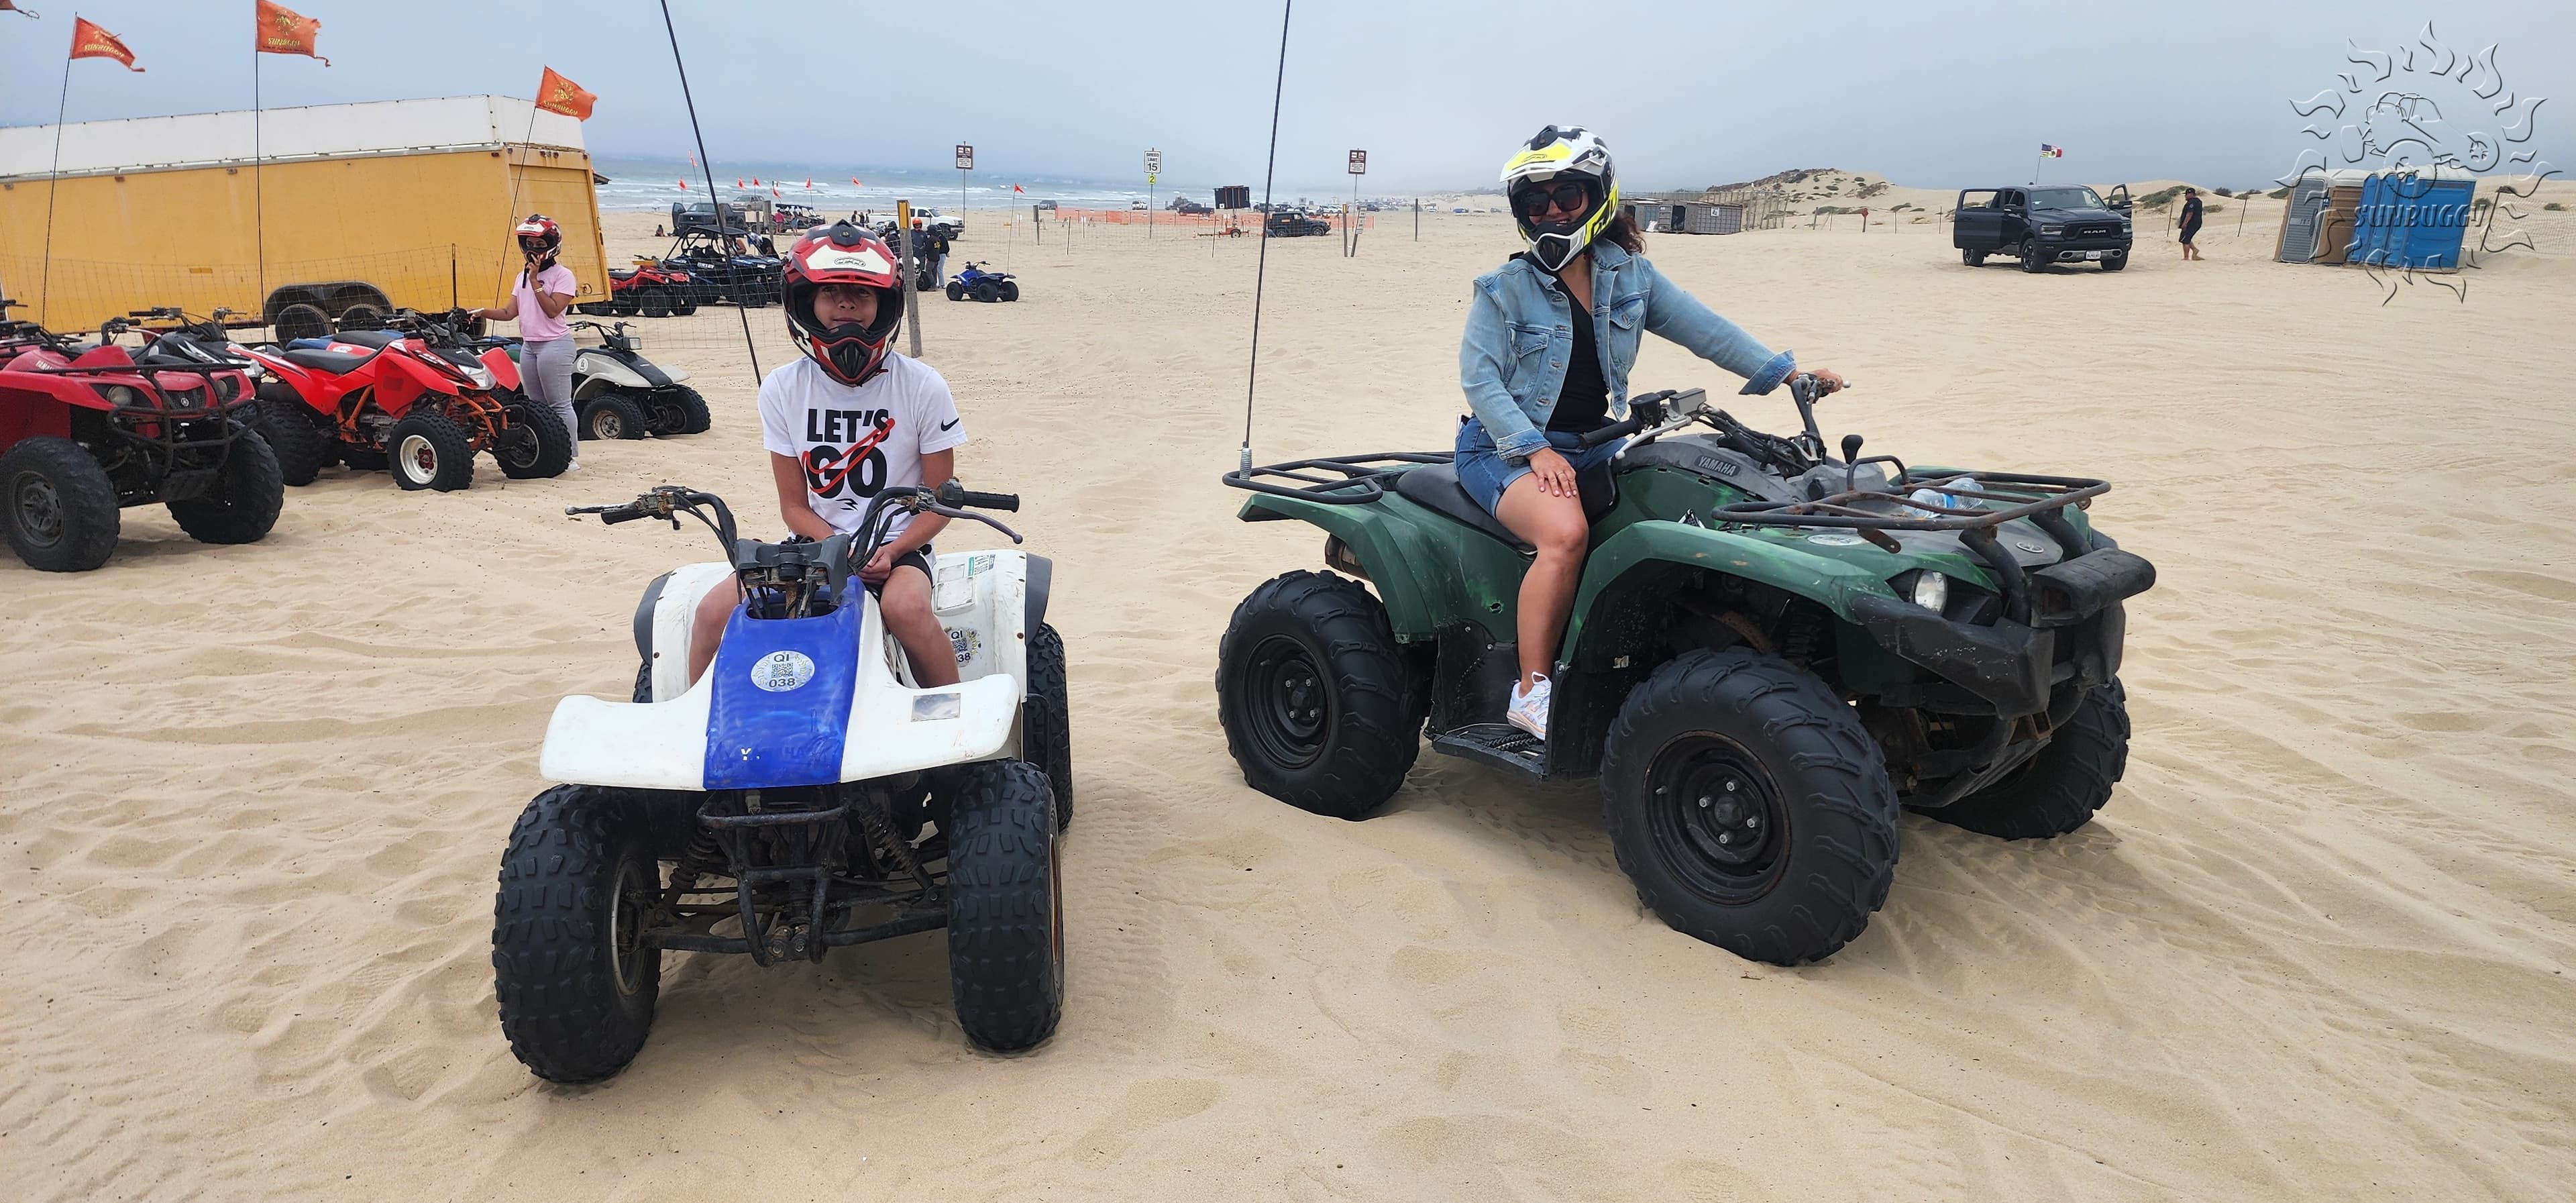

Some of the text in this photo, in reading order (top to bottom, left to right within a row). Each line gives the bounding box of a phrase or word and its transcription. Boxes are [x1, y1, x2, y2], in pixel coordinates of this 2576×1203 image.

[1147, 162, 1158, 171] 15
[806, 408, 891, 443] LET'S
[1698, 456, 1737, 476] YAMAHA
[805, 445, 888, 499] GO
[773, 653, 790, 662] QI
[956, 652, 971, 663] 38
[769, 678, 796, 688] 038
